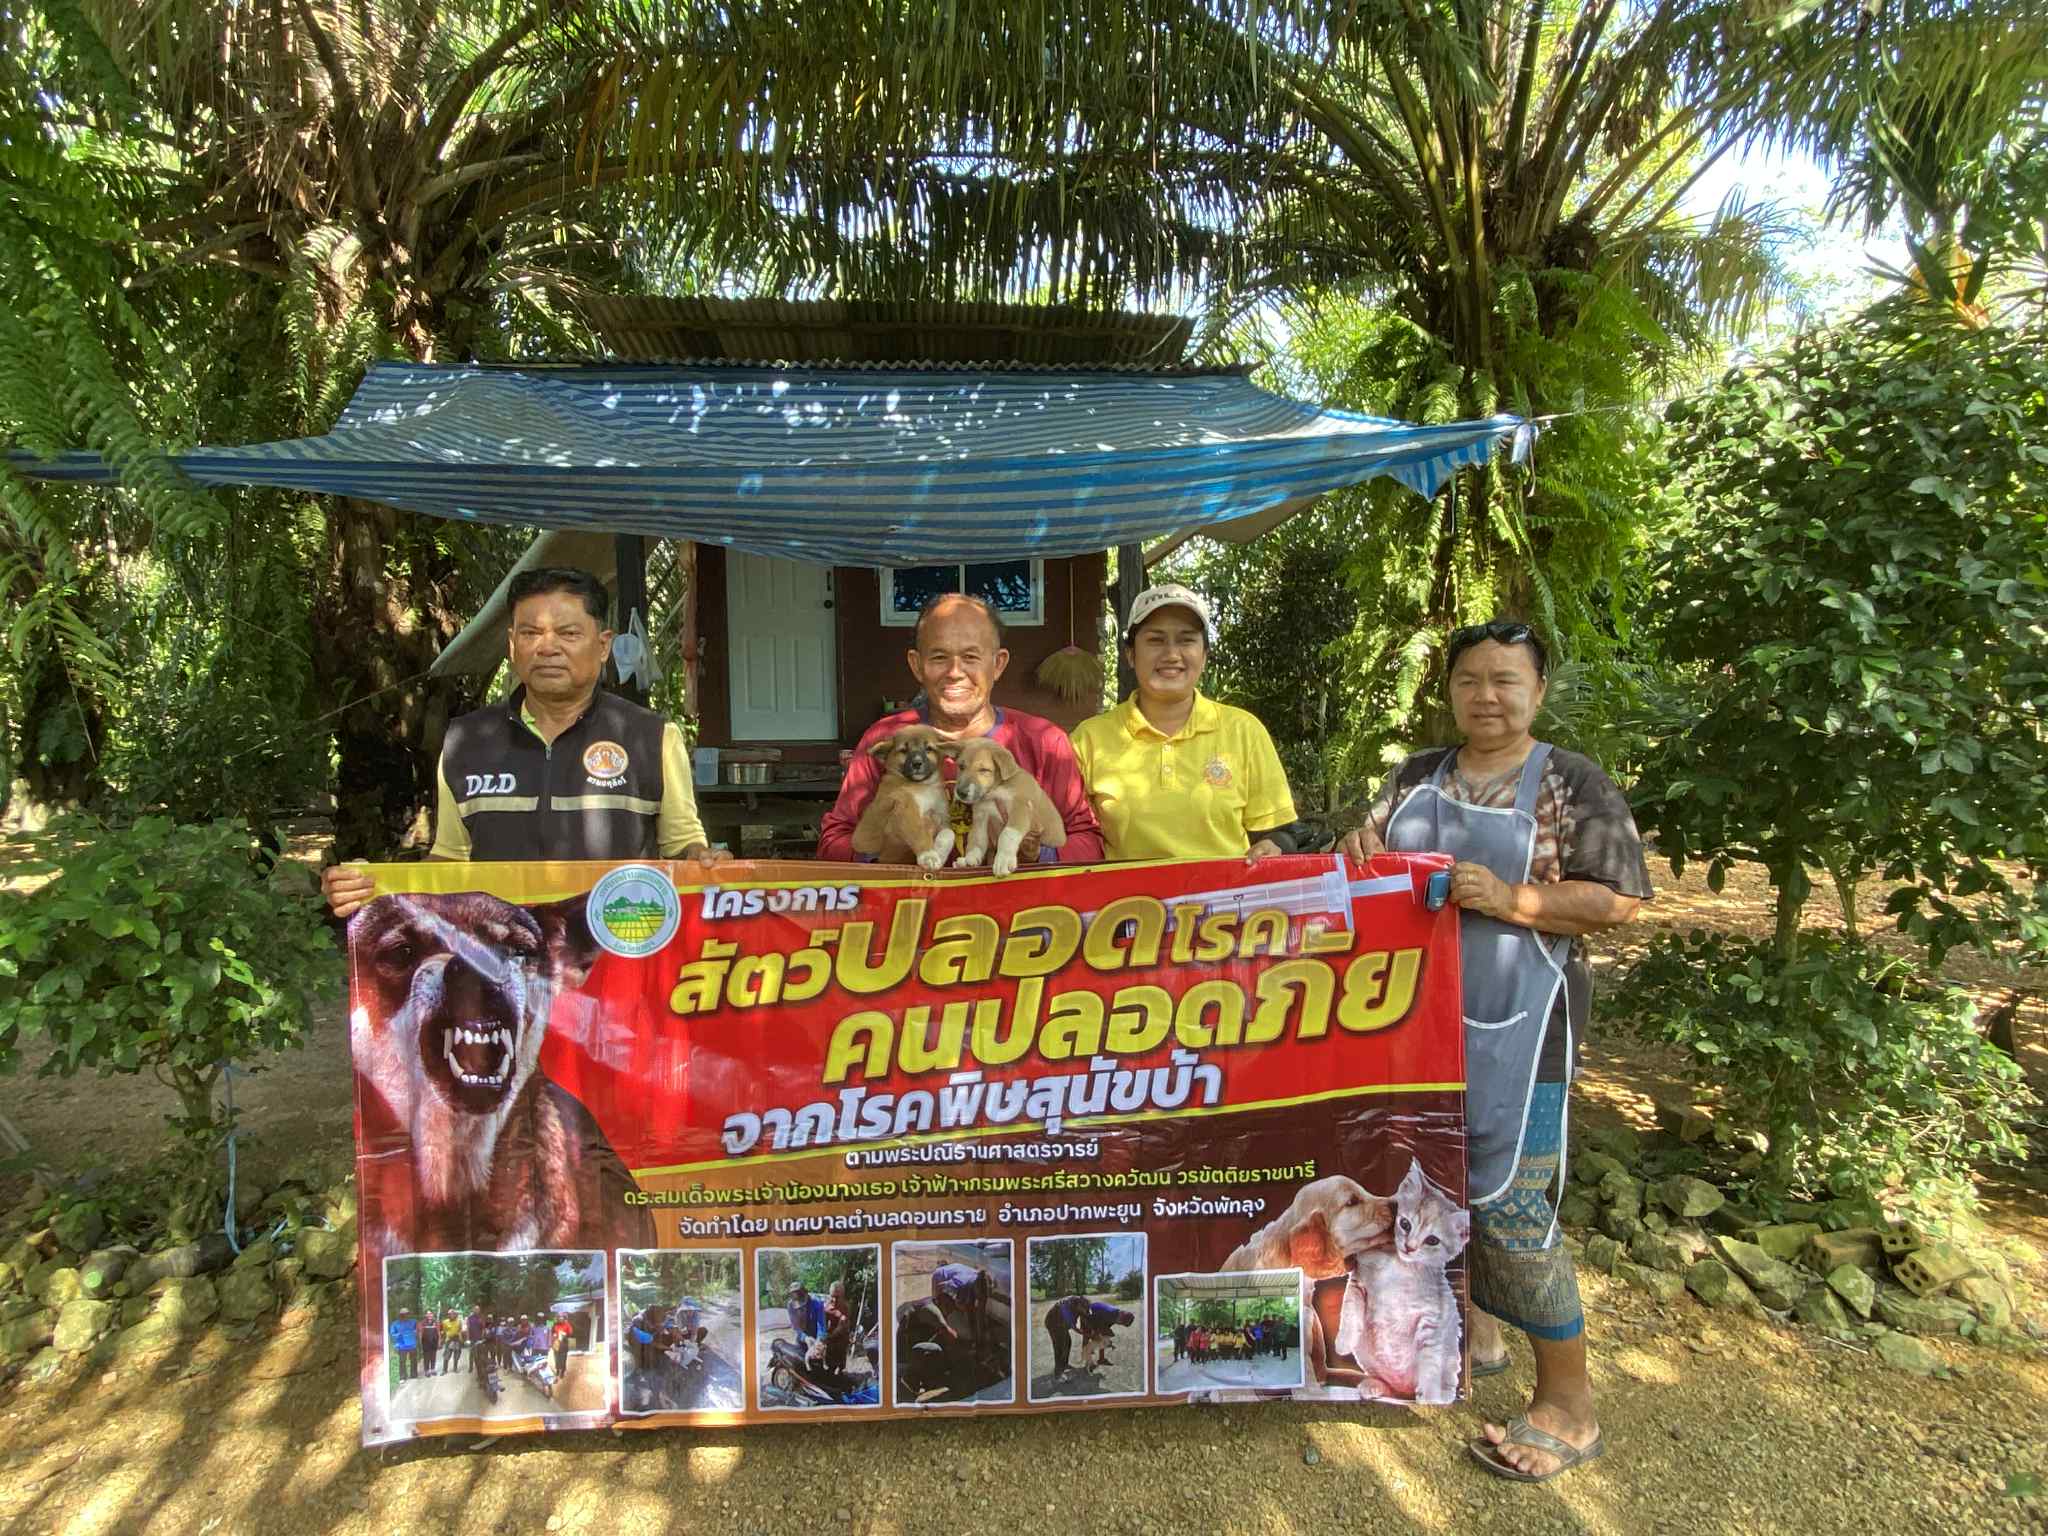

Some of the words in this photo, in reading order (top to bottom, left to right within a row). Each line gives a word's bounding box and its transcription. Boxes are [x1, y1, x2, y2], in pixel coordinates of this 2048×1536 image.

[466, 773, 516, 796] DLD
[701, 885, 860, 919] โครงการ
[823, 922, 1422, 1084] คนปลอดภัย
[721, 1048, 1222, 1155] จากโรคพิษสุนัขบ้า
[1177, 1160, 1316, 1185] วรขัตติยราชนารี
[680, 1214, 768, 1236] จัดทำโดย
[775, 1206, 987, 1233] เทศบาลตำบลดอนทราย
[999, 1202, 1142, 1224] อำเภอปากพะยูน
[1153, 1195, 1266, 1218] จังหวัดพัทลุง
